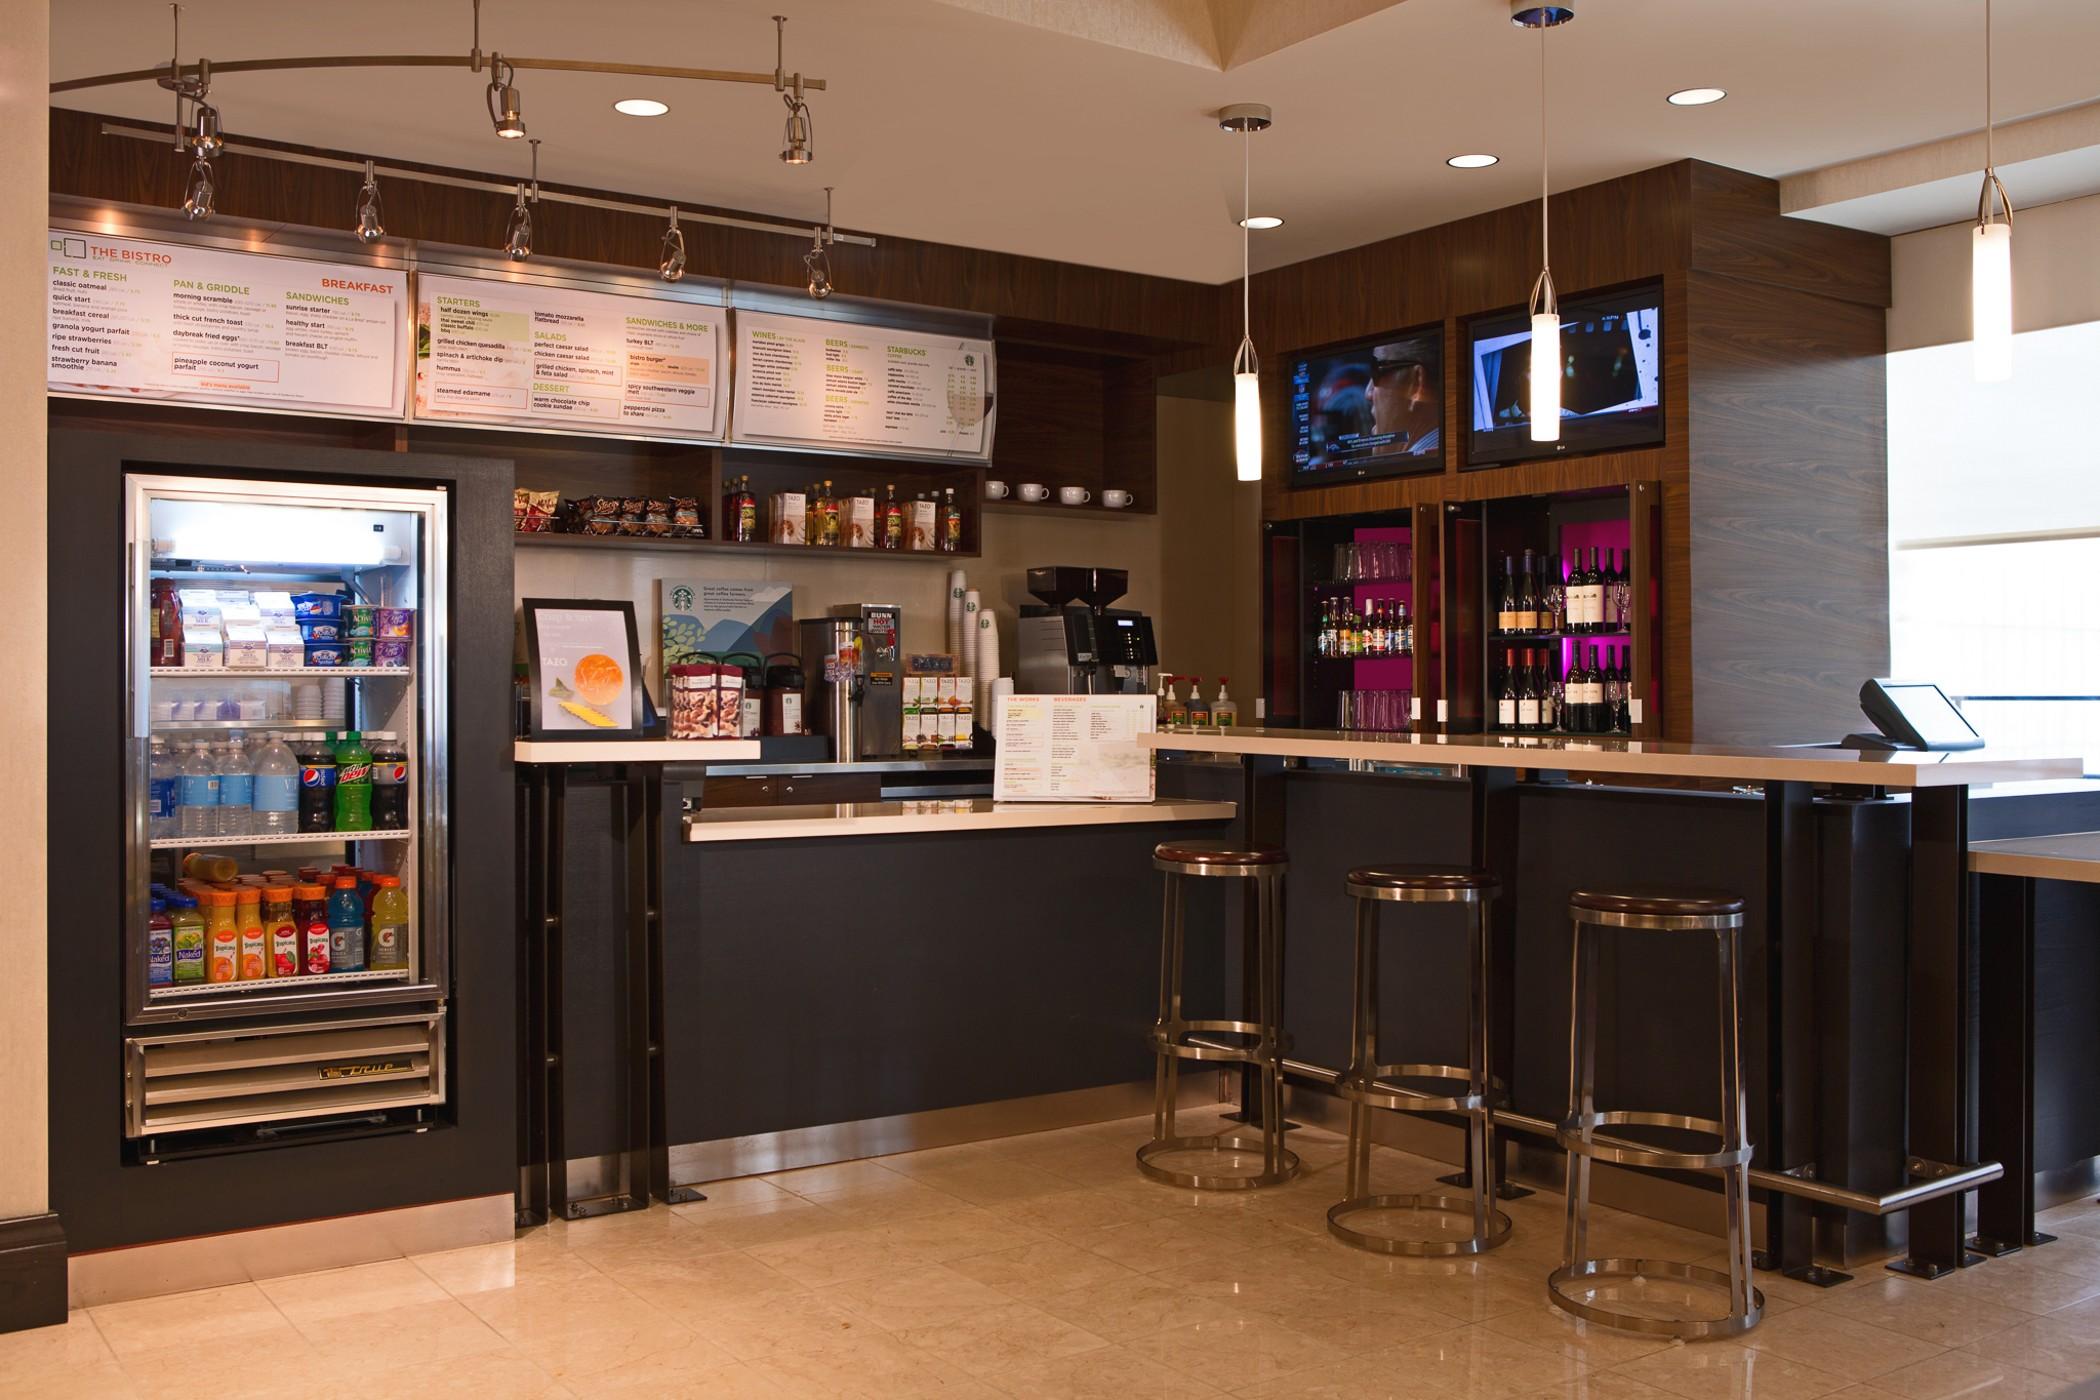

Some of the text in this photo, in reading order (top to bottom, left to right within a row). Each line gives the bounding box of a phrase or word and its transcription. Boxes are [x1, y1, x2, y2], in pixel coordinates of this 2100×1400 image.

[91, 247, 172, 264] THE BISTRO
[53, 266, 127, 282] FAST & FRESH
[53, 280, 76, 288] classic
[79, 283, 107, 291] oatmeal
[173, 280, 250, 295] PAN & GRIDDLE
[322, 278, 393, 295] BREAKFAST
[53, 294, 72, 303] quick
[173, 292, 233, 304] morning scramble
[286, 292, 349, 305] SANDWICHES
[437, 296, 480, 308] STARTERS
[53, 309, 86, 317] breakfast
[310, 306, 330, 315] starter
[453, 308, 471, 316] dozen
[204, 316, 225, 324] french
[555, 314, 584, 322] mozzarella
[52, 322, 130, 336] granola yogurt parfait
[286, 320, 309, 329] healthy
[626, 318, 678, 329] SANDWICHES
[686, 324, 709, 332] MORE
[52, 334, 112, 345] ripe strawberries
[173, 330, 204, 339] daybreak
[205, 332, 220, 340] fried
[534, 331, 567, 341] SALADS
[752, 331, 776, 340] WINES
[286, 341, 315, 349] breakfast
[437, 338, 506, 350] grilled chicken quesadilla
[826, 339, 848, 348] BEERS
[52, 345, 70, 353] fresh
[85, 347, 100, 355] fruit
[887, 346, 926, 356] STARBUCKS
[52, 356, 118, 367] strawberry banana
[437, 351, 460, 360] spinach
[466, 354, 492, 362] artichoke
[630, 354, 646, 362] bistro
[52, 363, 84, 371] smoothie
[174, 357, 259, 370] pineapple coconut yogurt
[436, 365, 461, 373] hummus
[827, 365, 848, 373] BEERS
[437, 388, 462, 396] steamed
[533, 383, 569, 393] DESSERT
[643, 385, 677, 393] southwestern
[551, 397, 577, 405] chocolate
[624, 405, 651, 413] pepperoni
[543, 658, 568, 666] TAZO
[331, 932, 346, 952] G
[378, 928, 395, 947] G
[178, 950, 201, 959] Naked
